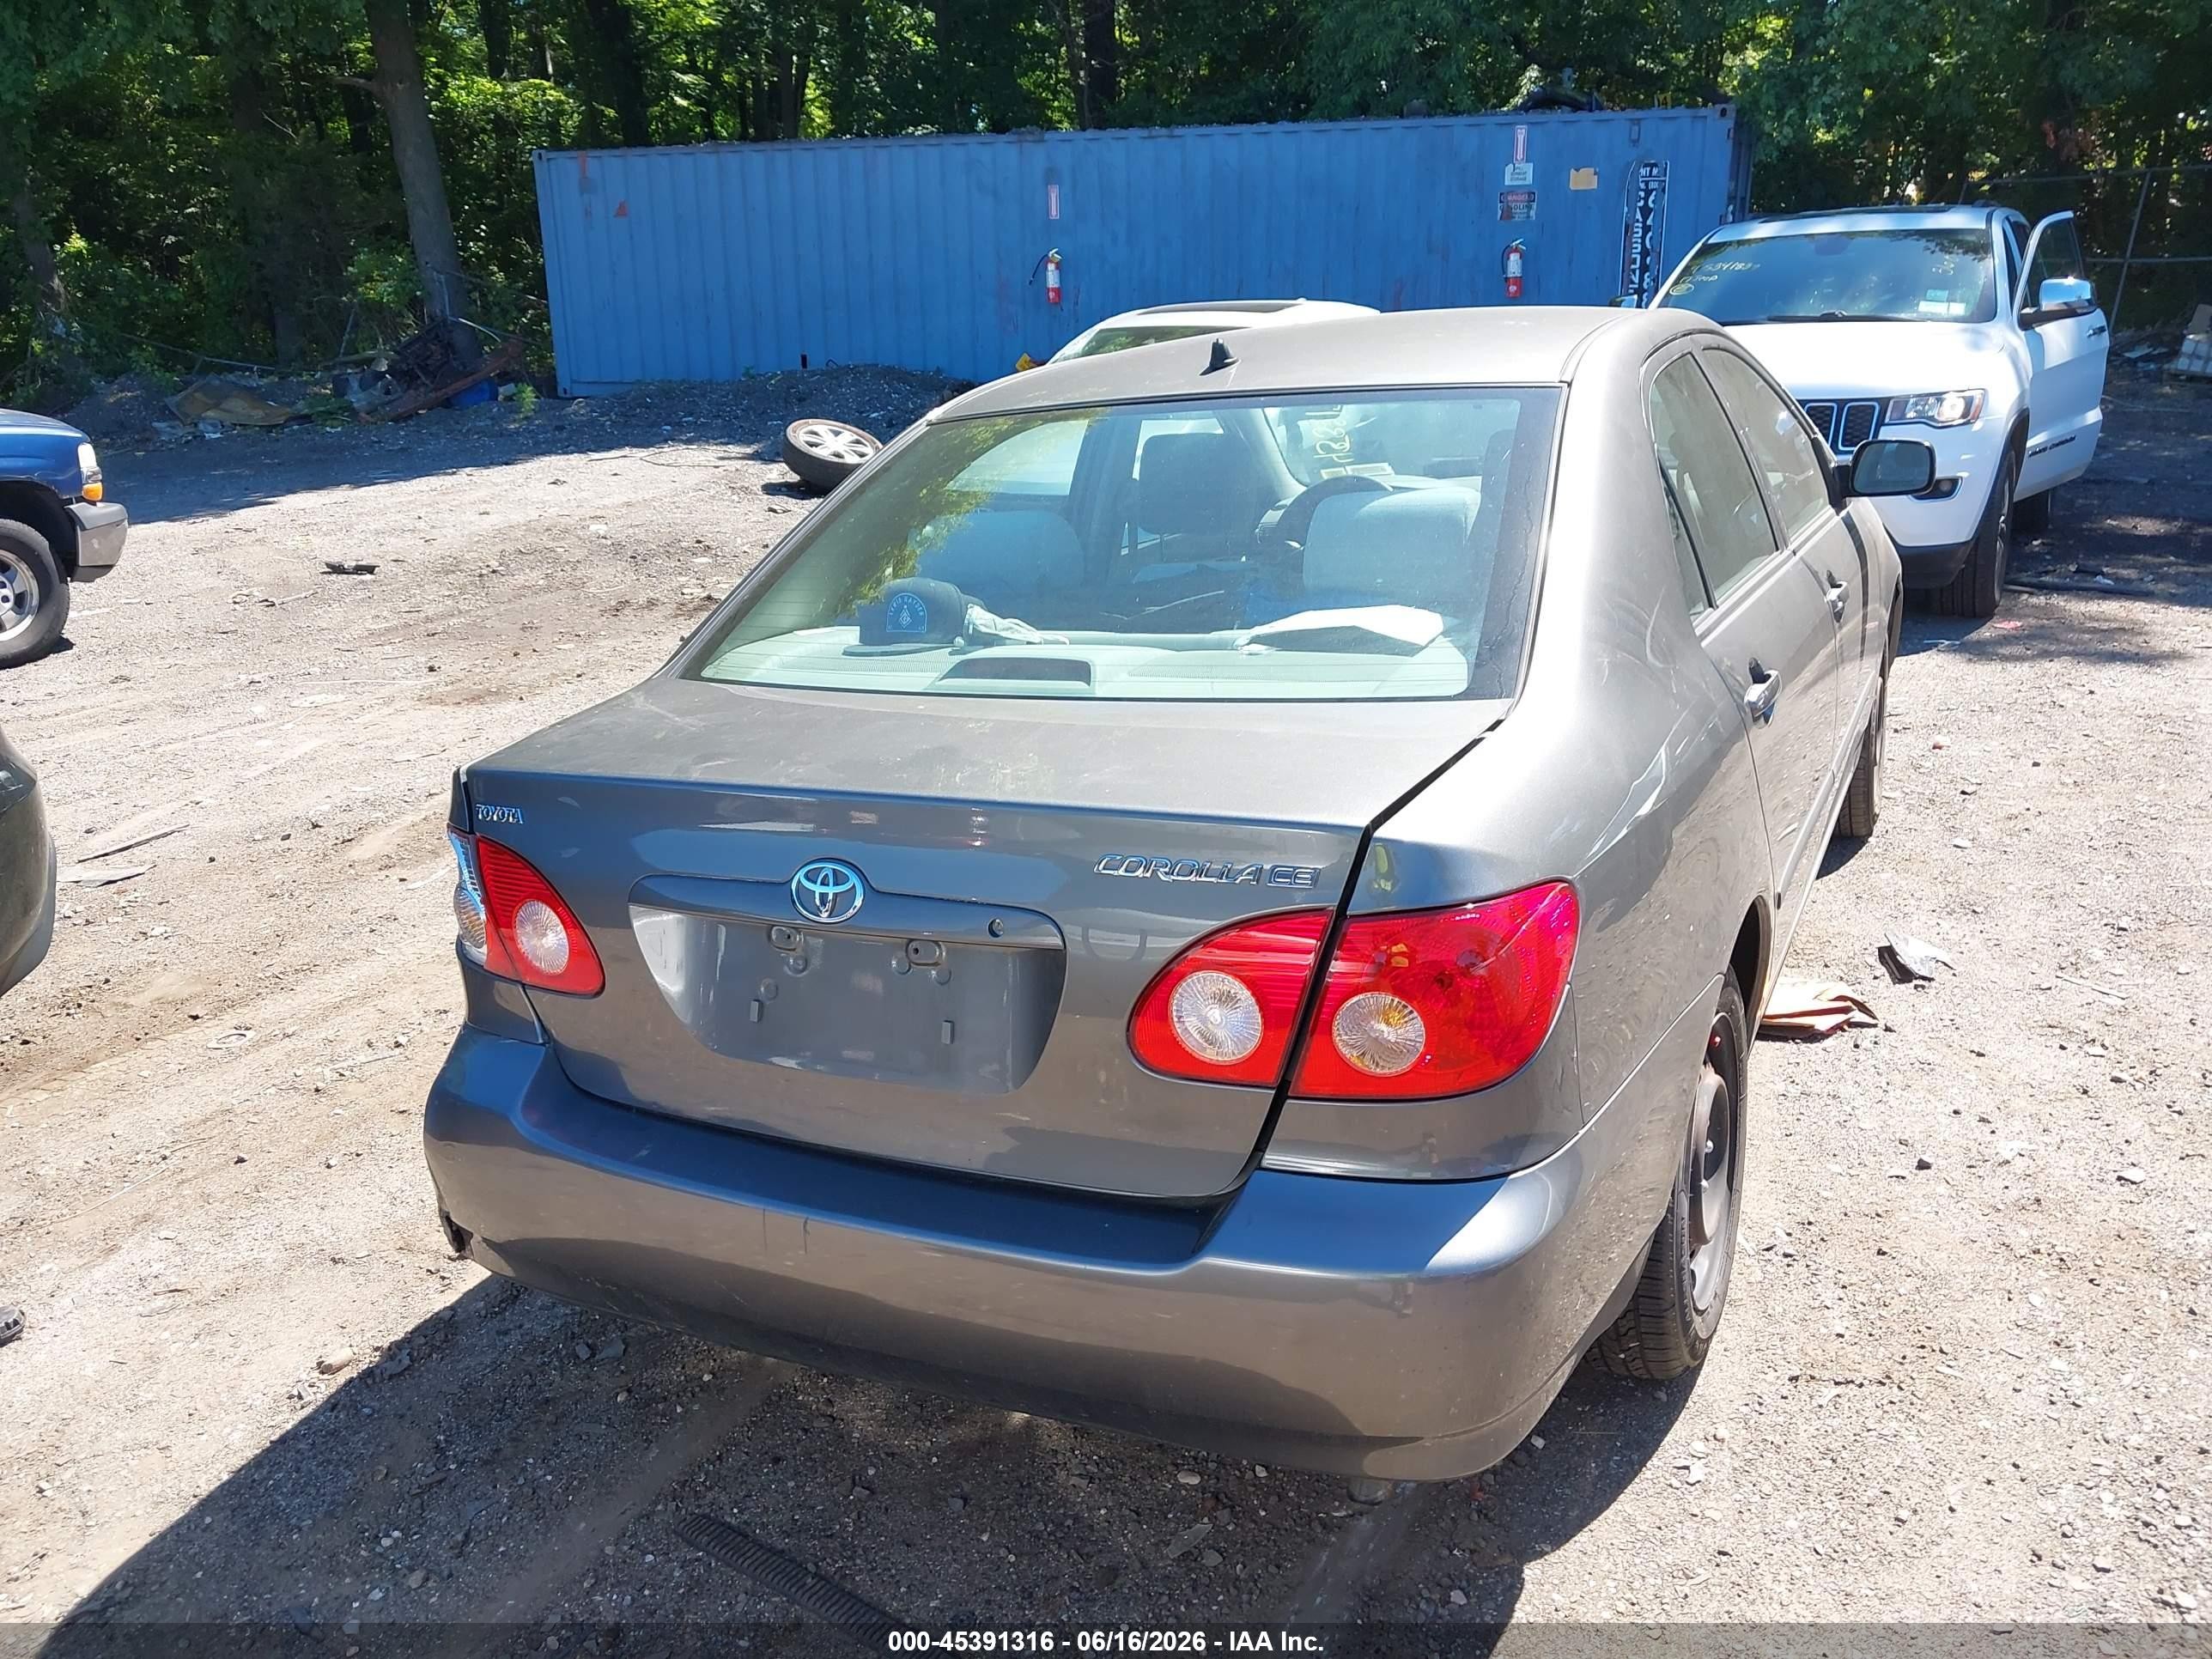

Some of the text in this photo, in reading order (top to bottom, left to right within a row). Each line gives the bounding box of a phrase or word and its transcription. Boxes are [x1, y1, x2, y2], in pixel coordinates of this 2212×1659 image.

[476, 804, 524, 824] TOYOTA
[1094, 854, 1319, 888] COROLLA CE
